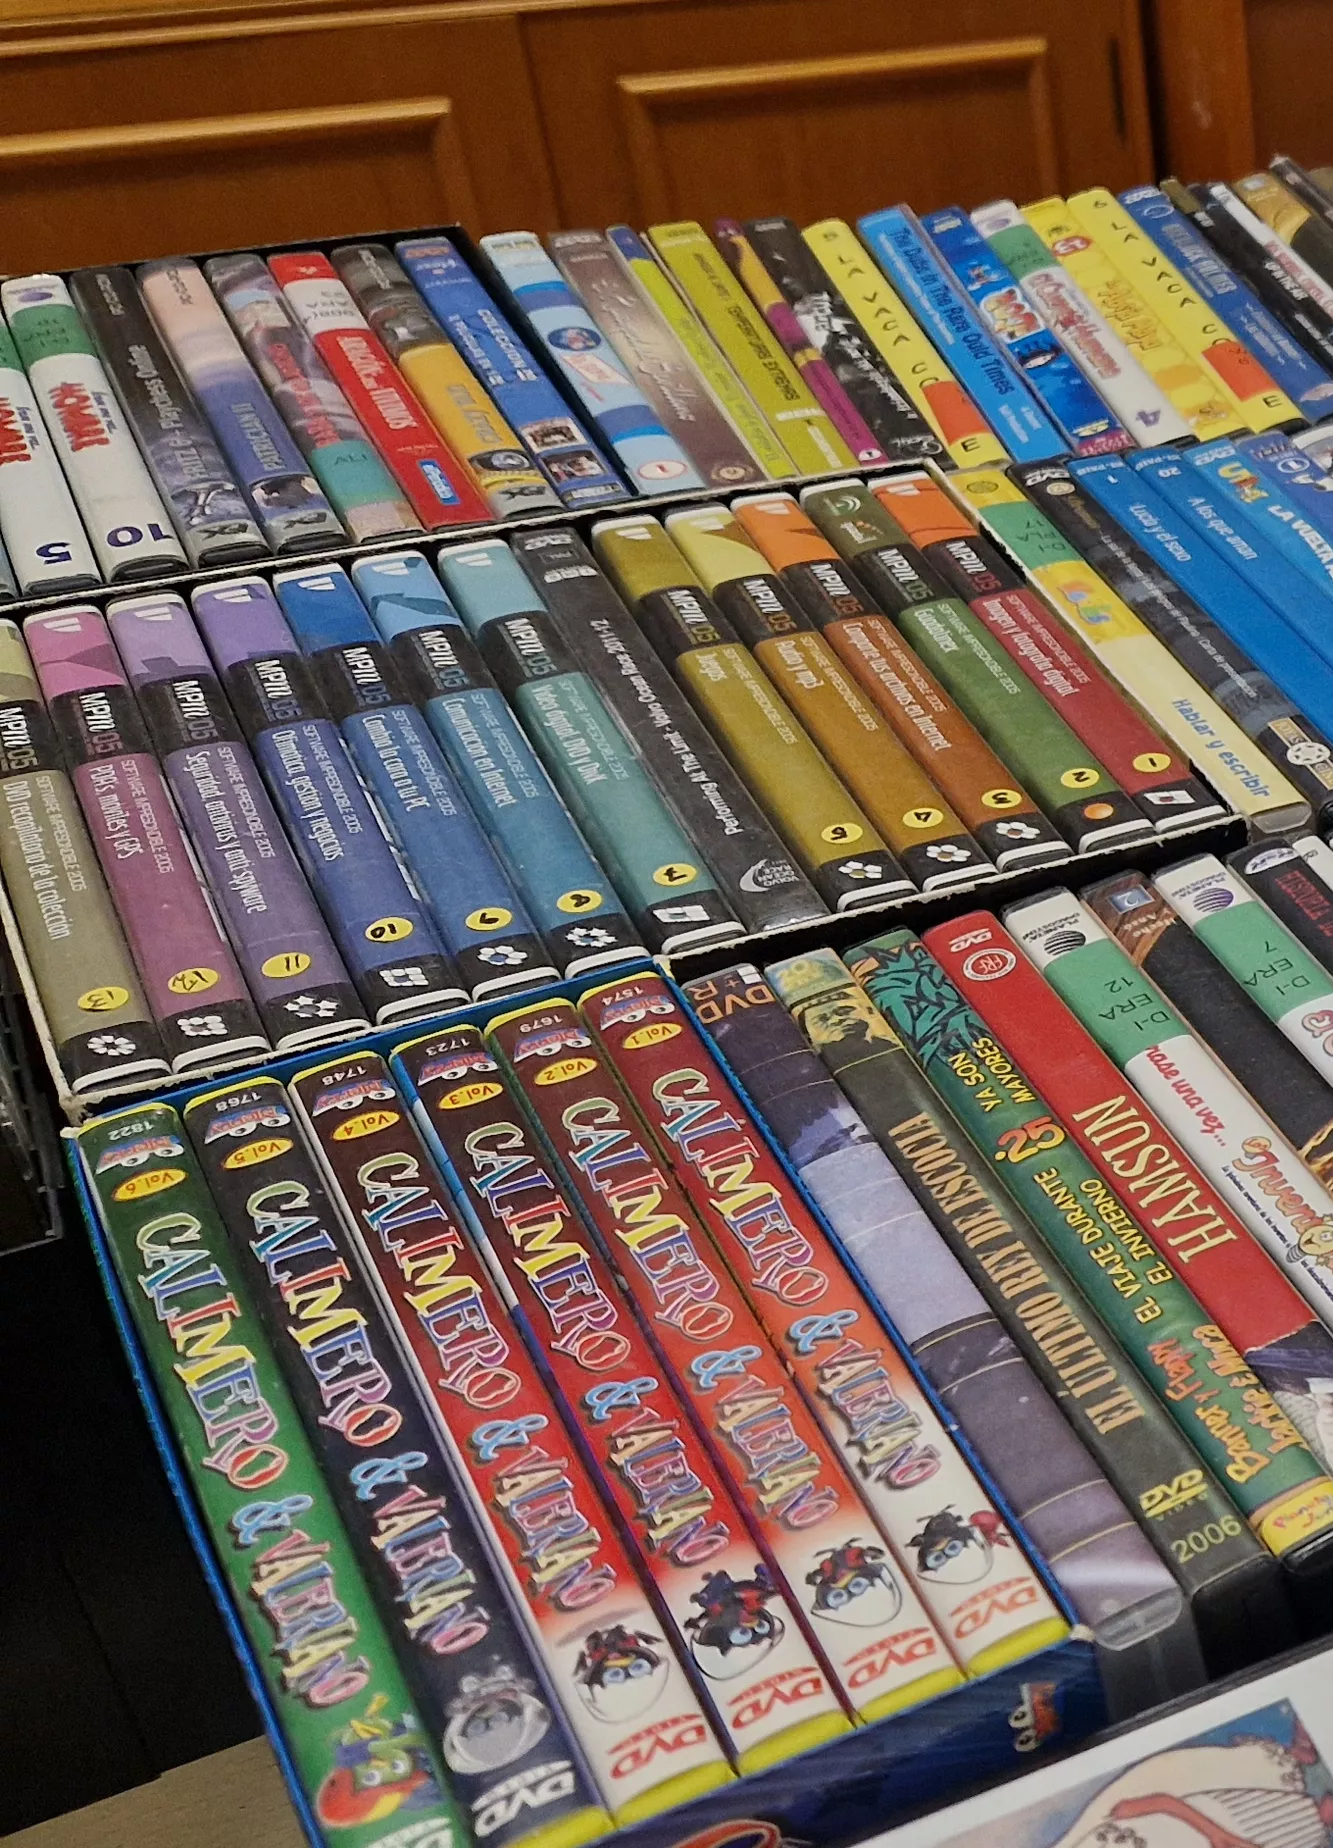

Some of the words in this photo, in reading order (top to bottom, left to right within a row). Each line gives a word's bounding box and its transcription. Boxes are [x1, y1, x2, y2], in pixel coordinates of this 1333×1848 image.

[1268, 505, 1294, 521] LA
[1285, 520, 1333, 565] VUELTA
[910, 608, 957, 653] Guadalinex
[1172, 699, 1214, 735] Hablar
[1219, 751, 1269, 796] escribir
[185, 751, 223, 801] Seguridad,
[204, 801, 238, 843] antivirus
[220, 849, 267, 913] anti-spyware
[601, 985, 646, 1006] 1574
[423, 1039, 471, 1058] 1723
[519, 1014, 564, 1033] 1679
[629, 1024, 679, 1048] Vol.1
[319, 1066, 369, 1087] 1748
[452, 1084, 498, 1108] Vol.3
[542, 1059, 591, 1084] Vol.2
[213, 1092, 262, 1111] 1768
[344, 1111, 394, 1139] Vol.4
[106, 1119, 155, 1140] 1822
[233, 1140, 287, 1167] Vol.5
[123, 1169, 181, 1198] Vol.6
[900, 1111, 988, 1209] ESCOCIA
[1080, 1099, 1230, 1256] HAMSUN
[651, 1064, 829, 1309] CALIMERO
[1036, 1168, 1102, 1243] DURANTE
[558, 1093, 735, 1344] CALIMERO
[963, 1198, 998, 1237] DE
[1081, 1179, 1153, 1259] INVIERNO
[464, 1120, 631, 1375] CALIMERO
[988, 1234, 1037, 1293] REY
[1092, 1246, 1140, 1297] VIAJE
[1146, 1261, 1174, 1284] EL
[355, 1153, 522, 1411] CALIMERO
[247, 1179, 404, 1451] CALIMERO
[789, 1305, 859, 1357] &
[1134, 1303, 1163, 1323] EL
[136, 1213, 288, 1491] CALIMERO
[690, 1344, 765, 1395] &
[1021, 1288, 1124, 1399] ÚLTIMO
[584, 1375, 657, 1430] &
[813, 1333, 942, 1491] VALERIANO
[1088, 1385, 1145, 1434] EL
[473, 1412, 550, 1461] &
[715, 1374, 838, 1533] VALERIANO
[351, 1451, 425, 1504] &
[607, 1402, 730, 1567] VALERIANO
[232, 1494, 311, 1550] &
[495, 1442, 619, 1612] VALERIANO
[1171, 1514, 1243, 1564] 2006
[372, 1483, 490, 1657] VALERIANO
[247, 1534, 369, 1709] VALERIANO
